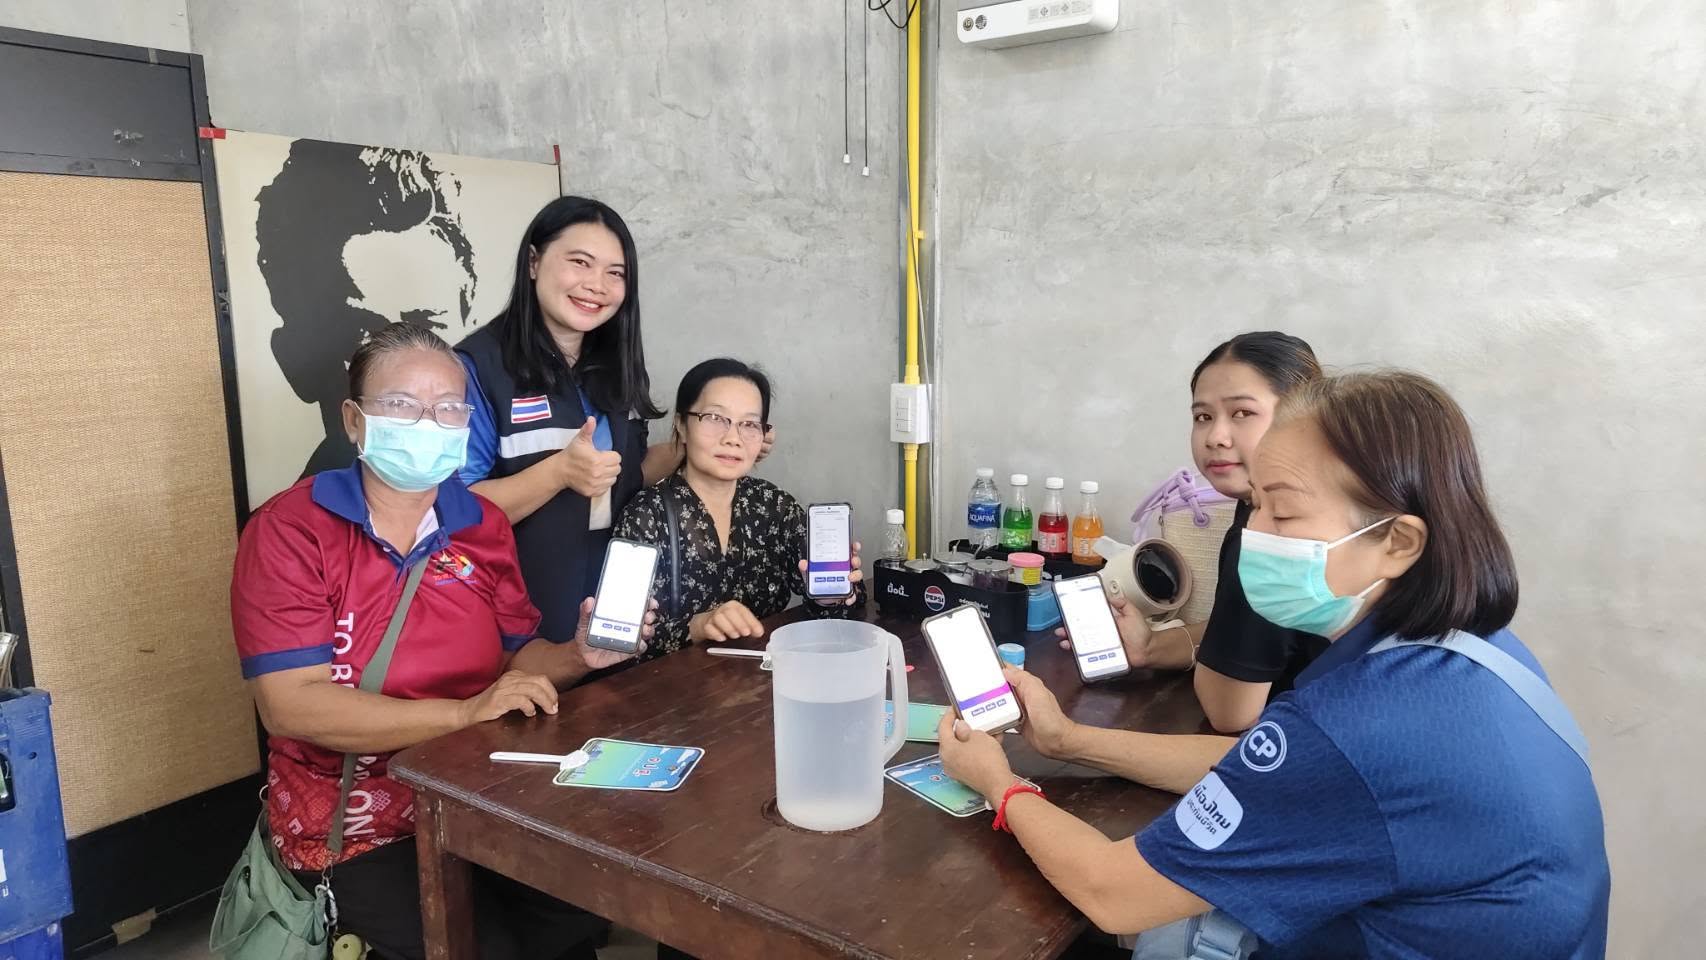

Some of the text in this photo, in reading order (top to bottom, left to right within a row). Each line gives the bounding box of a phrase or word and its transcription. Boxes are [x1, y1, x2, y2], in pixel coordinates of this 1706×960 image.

[925, 593, 944, 603] PEPSI
[332, 612, 354, 655] TO
[331, 664, 355, 689] B
[1249, 730, 1277, 758] CP
[343, 790, 376, 838] ON
